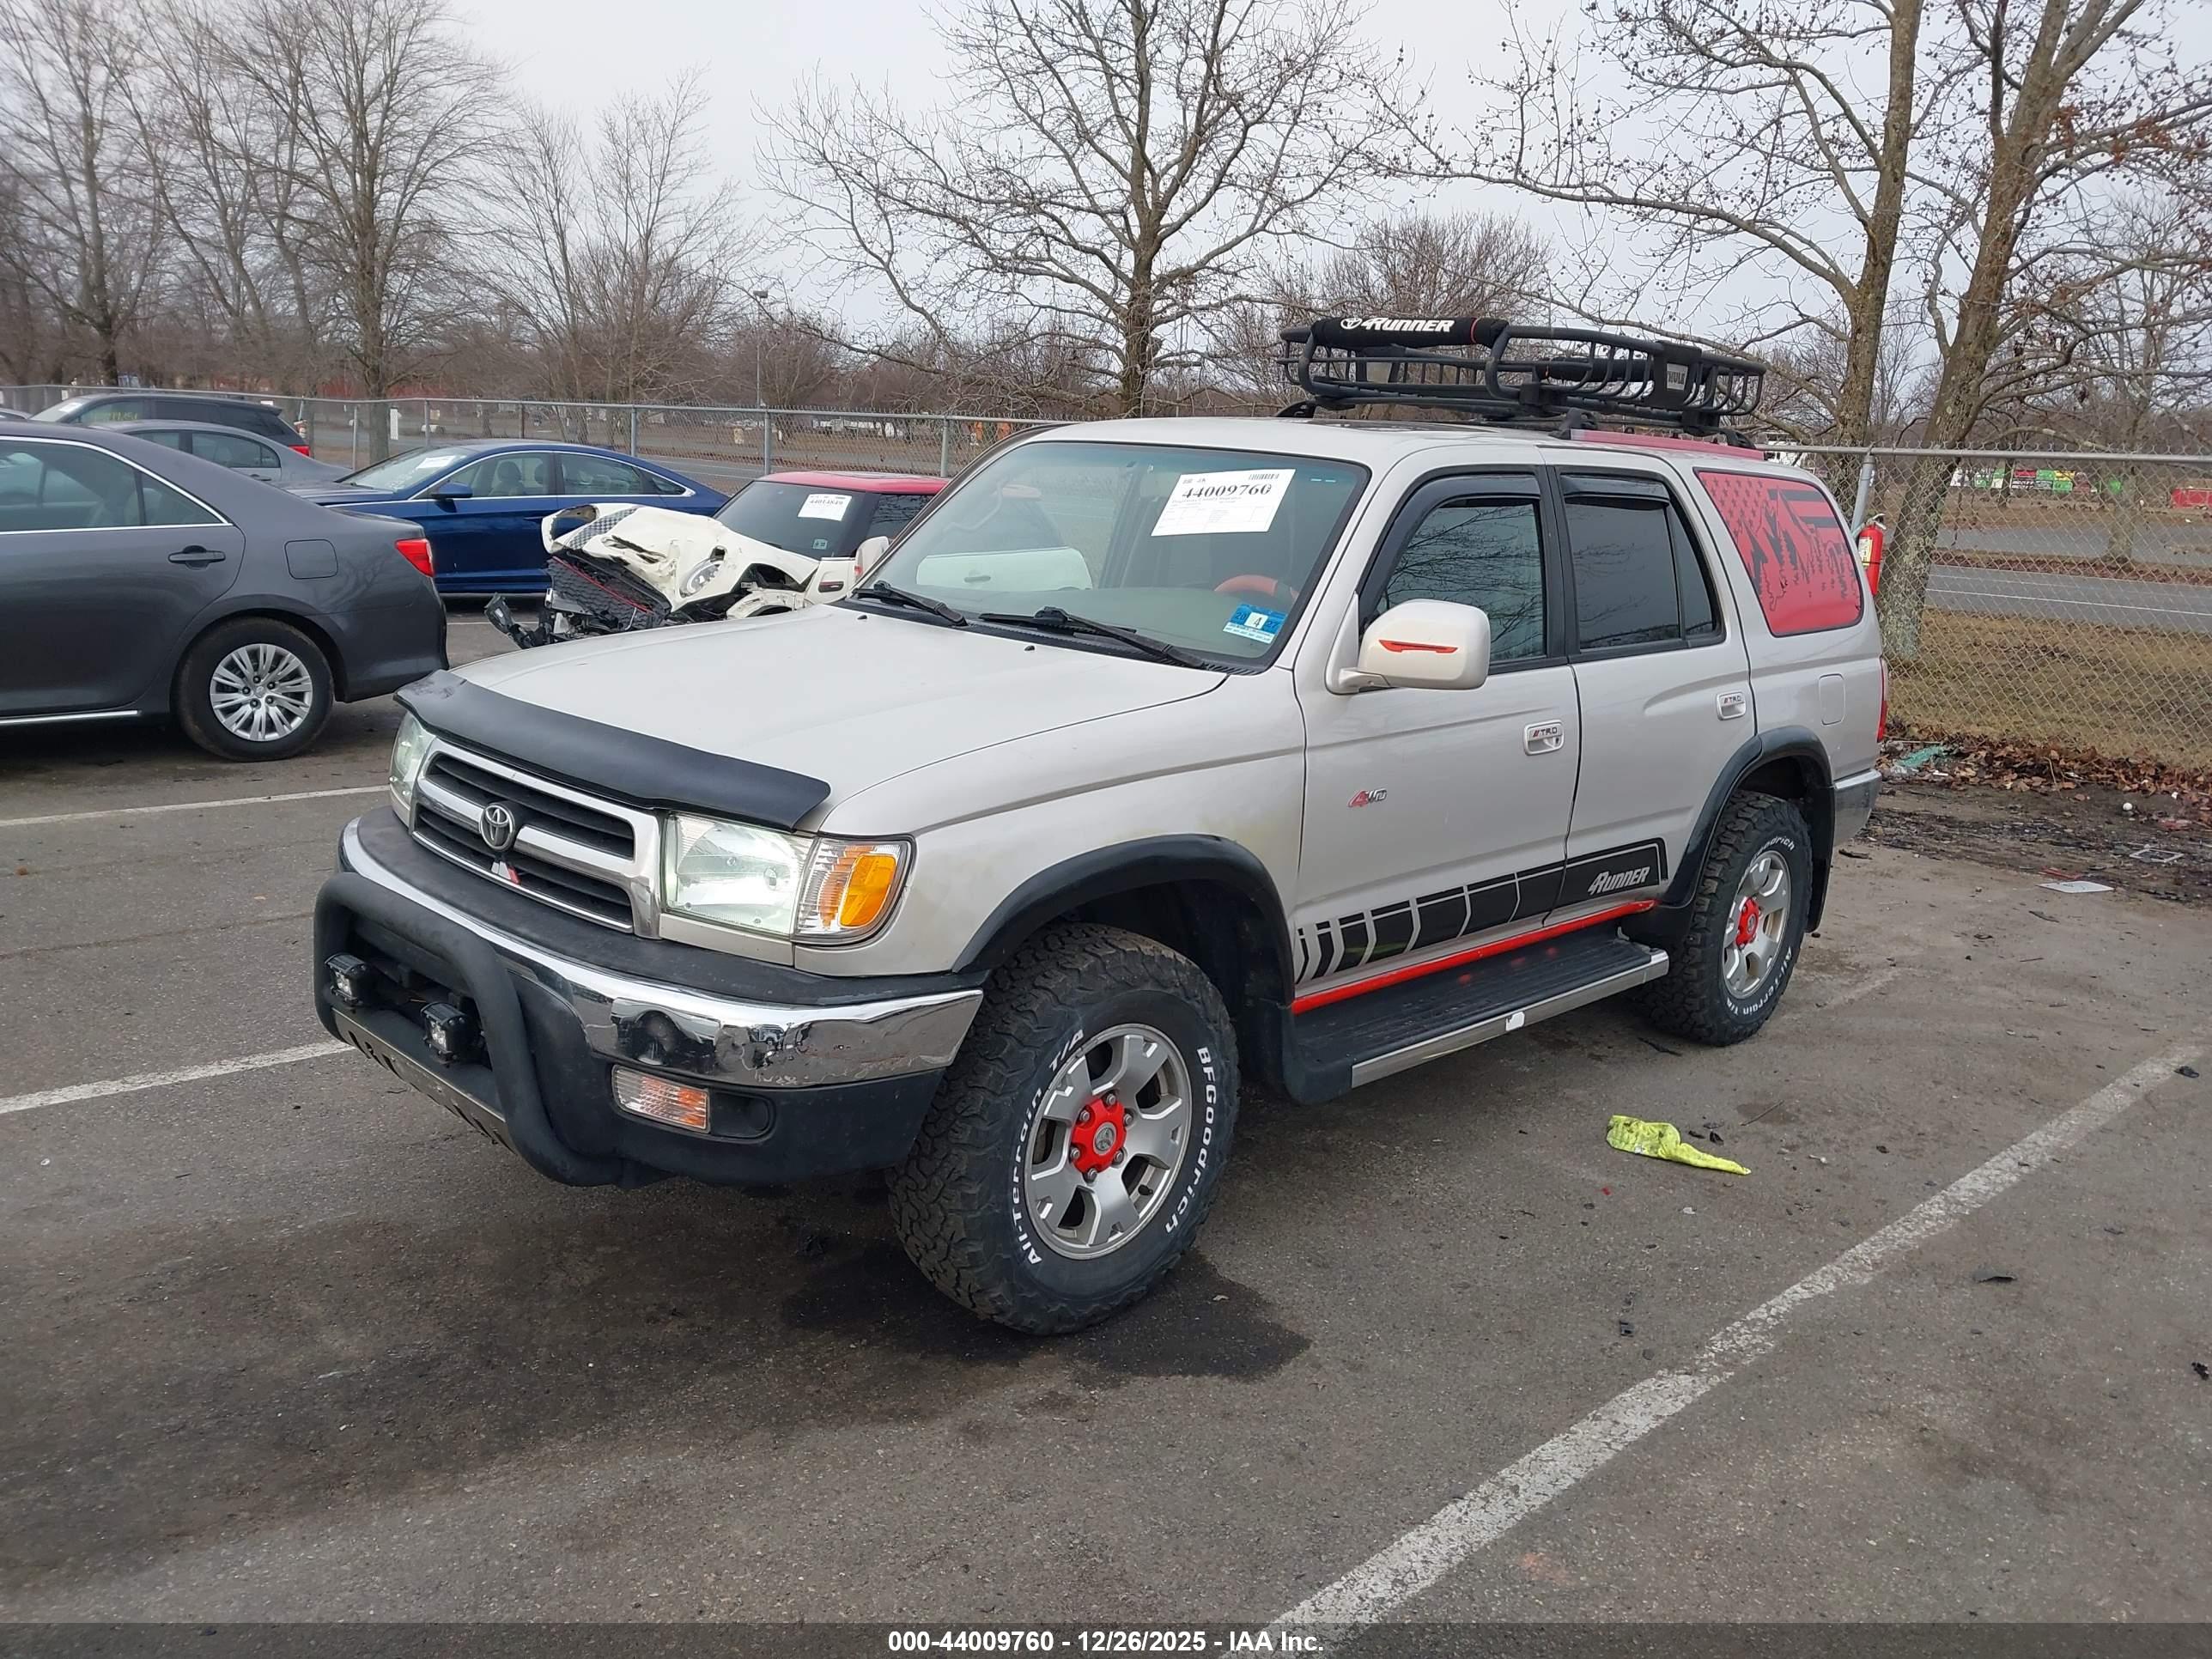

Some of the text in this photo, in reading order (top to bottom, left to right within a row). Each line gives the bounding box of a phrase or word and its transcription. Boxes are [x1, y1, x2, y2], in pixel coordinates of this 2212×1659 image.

[1182, 483, 1272, 499] 44009760
[1254, 617, 1263, 628] 4
[1743, 945, 1792, 1015] All-Terrain
[1012, 1030, 1085, 1265] All-Terrain T/A
[1164, 1047, 1217, 1234] BFGoodrich
